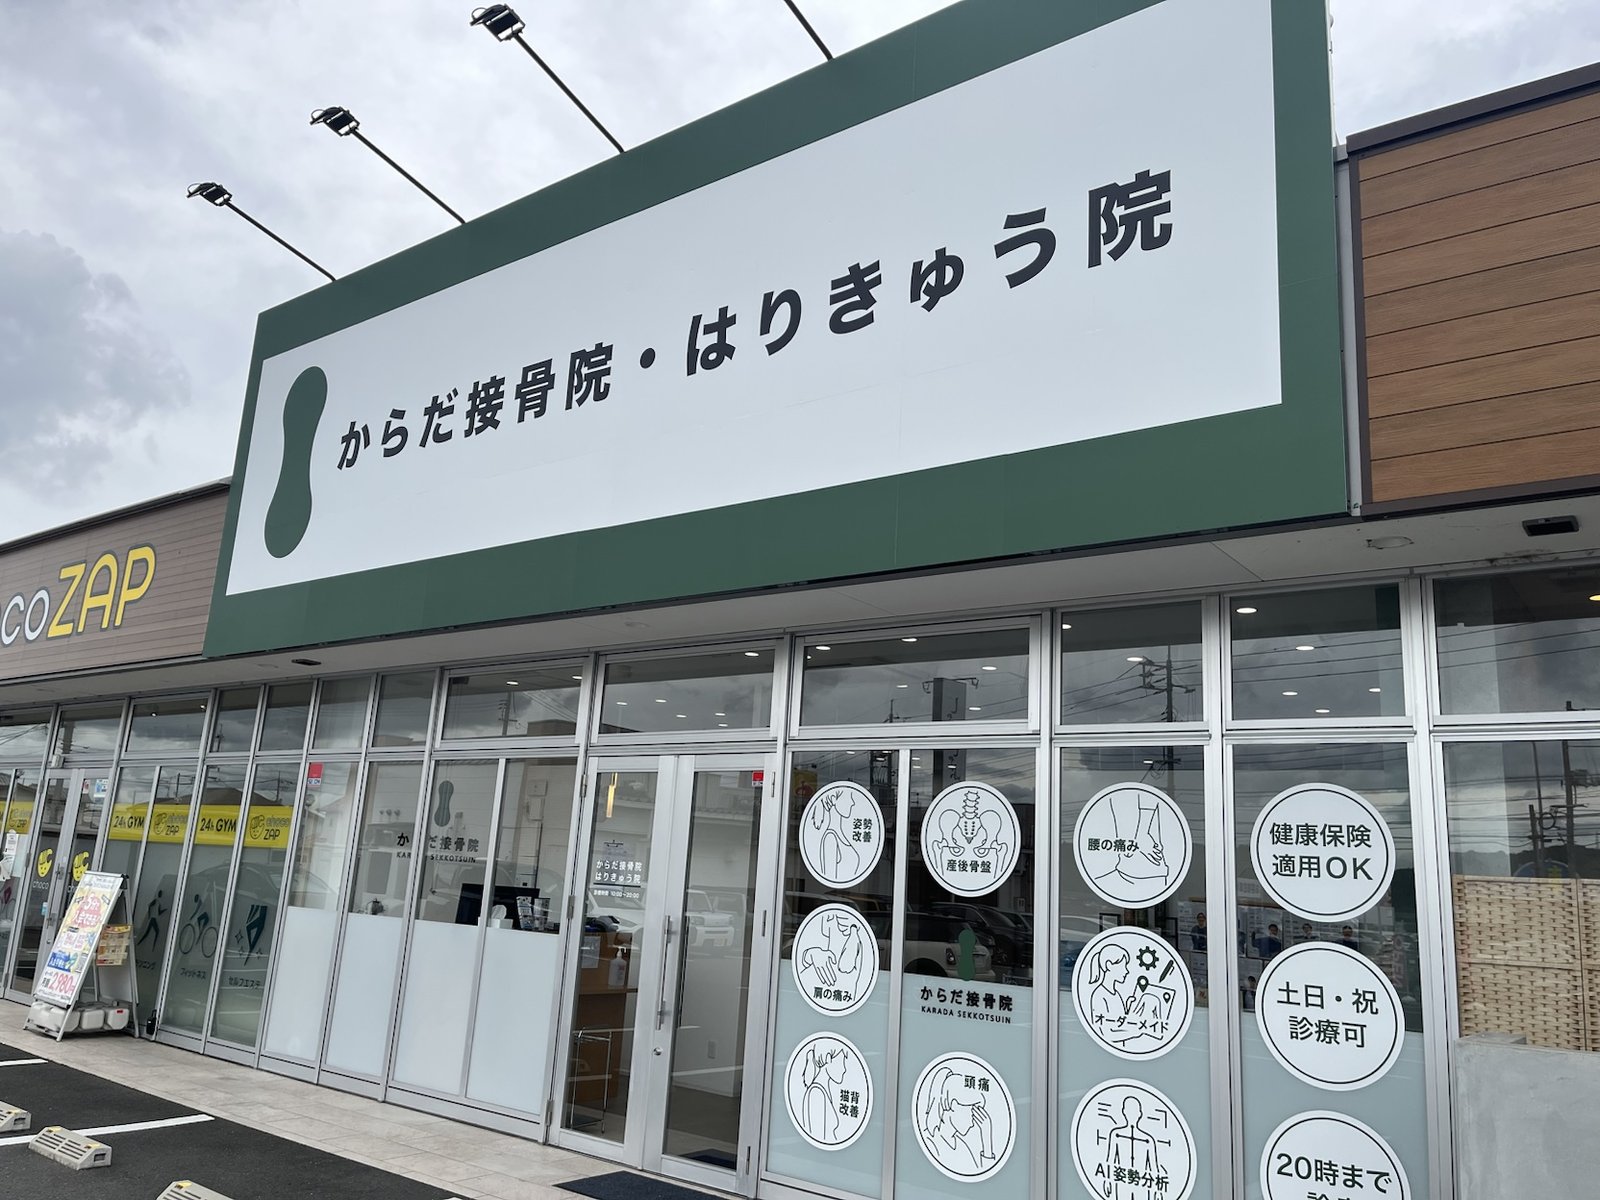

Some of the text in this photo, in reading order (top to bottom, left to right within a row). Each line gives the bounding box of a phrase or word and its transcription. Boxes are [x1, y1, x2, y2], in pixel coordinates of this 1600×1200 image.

[336, 168, 1174, 471] からだ接骨院・はりきゅう院
[127, 816, 145, 829] GYM
[165, 825, 180, 836] ZAP
[215, 818, 237, 832] GYM
[852, 817, 873, 830] 姿勢
[263, 829, 281, 841] ZAP
[852, 830, 873, 842] 改善
[1269, 822, 1372, 848] 健康保険
[1087, 837, 1140, 853] 腰の痛み
[596, 860, 643, 872] からだ接骨院
[946, 858, 992, 873] 産後骨盤
[1272, 853, 1373, 880] 適用OK
[595, 871, 641, 884] はりきゅう院
[813, 986, 852, 1003] 肩の痛み
[920, 986, 1013, 1012] からだ接骨院
[1277, 981, 1379, 1015] 土日・祝
[921, 1005, 1011, 1024] KARADA SEKKOTSUIN
[1095, 1013, 1169, 1033] オーダーメイド
[1288, 1015, 1367, 1048] 診療可
[963, 1075, 991, 1093] 頭痛
[839, 1088, 860, 1104] 猫背
[838, 1102, 859, 1118] 改善
[1276, 1152, 1393, 1194] 20時まで
